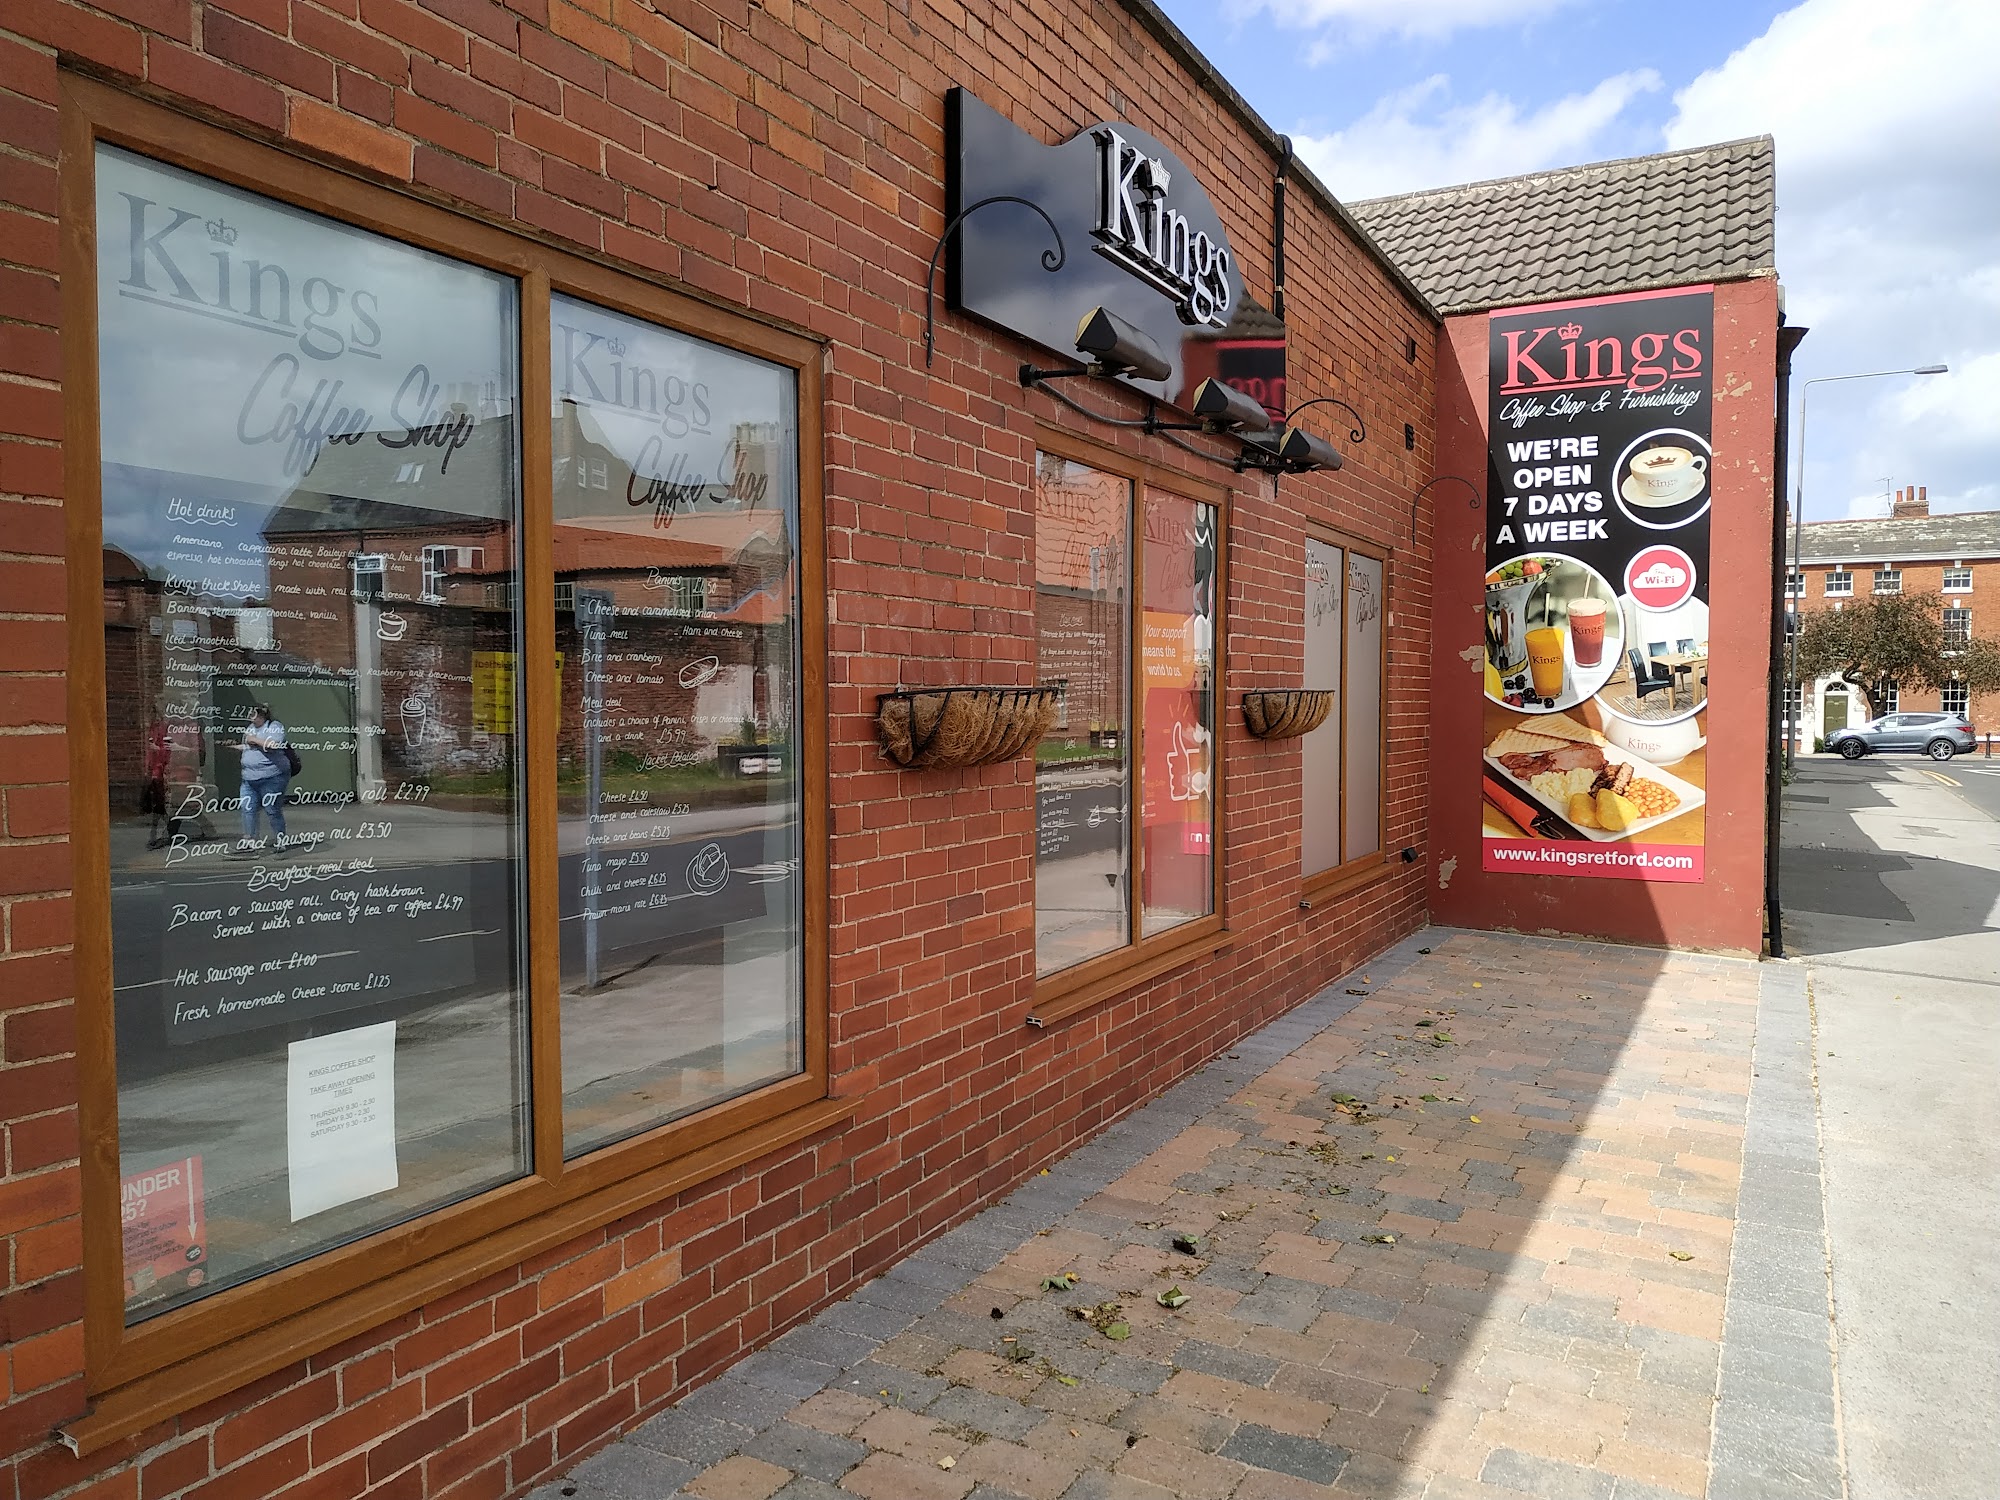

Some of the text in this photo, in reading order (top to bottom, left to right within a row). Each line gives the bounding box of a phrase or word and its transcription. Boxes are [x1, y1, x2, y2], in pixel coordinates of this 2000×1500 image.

[1090, 127, 1229, 325] Kings
[118, 192, 381, 360] Kings
[1501, 326, 1702, 392] Kings
[558, 324, 711, 439] Kings
[237, 353, 475, 476] Coffee Shop
[1500, 384, 1701, 428] Coffee Shop & Furnishings
[1507, 436, 1598, 462] WE'RE
[627, 435, 768, 529] Coffee Shop
[1514, 464, 1592, 489] OPEN
[168, 498, 235, 520] Hot drinks
[1504, 492, 1603, 516] 7 DAYS
[1496, 519, 1609, 544] A WEEK
[646, 567, 683, 585] Paninis
[1645, 576, 1675, 585] Wi-Fi
[164, 573, 197, 595] Kings
[275, 584, 301, 594] made
[305, 584, 327, 596] with
[331, 585, 347, 596] real
[388, 591, 411, 600] cream
[588, 599, 619, 615] Cheese
[622, 607, 639, 615] and
[584, 624, 606, 640] Tuna
[683, 625, 701, 635] Ham
[704, 627, 718, 635] and
[1145, 625, 1187, 640] Your support
[1573, 625, 1602, 637] Kings
[190, 635, 239, 646] smoothies
[1143, 645, 1176, 658] means the
[1532, 655, 1560, 665] Kings
[585, 671, 613, 683] Cheese
[616, 675, 632, 683] and
[1147, 664, 1164, 676] world
[1165, 664, 1172, 676] to
[165, 676, 212, 695] Strawberry
[217, 679, 234, 687] and
[238, 678, 263, 688] cream
[267, 679, 286, 687] with
[581, 696, 622, 708] Meal deal
[291, 741, 320, 750] cream
[323, 741, 336, 751] for
[598, 735, 612, 743] and
[1628, 738, 1661, 752] Kings
[636, 753, 668, 772] Jacket
[171, 782, 430, 821] Bacon or Sausage roll £2.99
[600, 791, 626, 803] Cheese
[621, 810, 637, 819] and
[165, 833, 229, 867] Bacon
[237, 838, 265, 851] and
[330, 826, 351, 840] roll
[356, 822, 392, 839] £3.50
[614, 833, 628, 841] and
[629, 830, 648, 839] beans
[582, 858, 601, 873] Tuna
[606, 858, 627, 875] mayo
[1493, 848, 1693, 868] www.kingsretford.com
[247, 857, 375, 891] Breakfast meal deal
[606, 881, 621, 891] and
[168, 903, 222, 931] Bacon
[228, 905, 242, 917] or
[213, 921, 254, 938] Served
[262, 917, 291, 931] with
[297, 914, 304, 924] a
[348, 907, 358, 923] of
[365, 904, 381, 915] tea
[387, 903, 398, 912] or
[404, 898, 432, 918] coffee
[435, 893, 464, 912] £4.99
[174, 968, 199, 987] Hot
[174, 1002, 211, 1025] Fresh
[217, 991, 285, 1014] homemade
[330, 980, 361, 994] scone
[309, 1055, 376, 1076] KINGS COFFEE SHOP
[310, 1072, 375, 1094] TAKE AWAY OPENING
[334, 1087, 353, 1097] TIMES
[310, 1106, 345, 1121] THURSDAY
[316, 1115, 339, 1127] FRIDAY
[310, 1123, 344, 1138] SATURDAY
